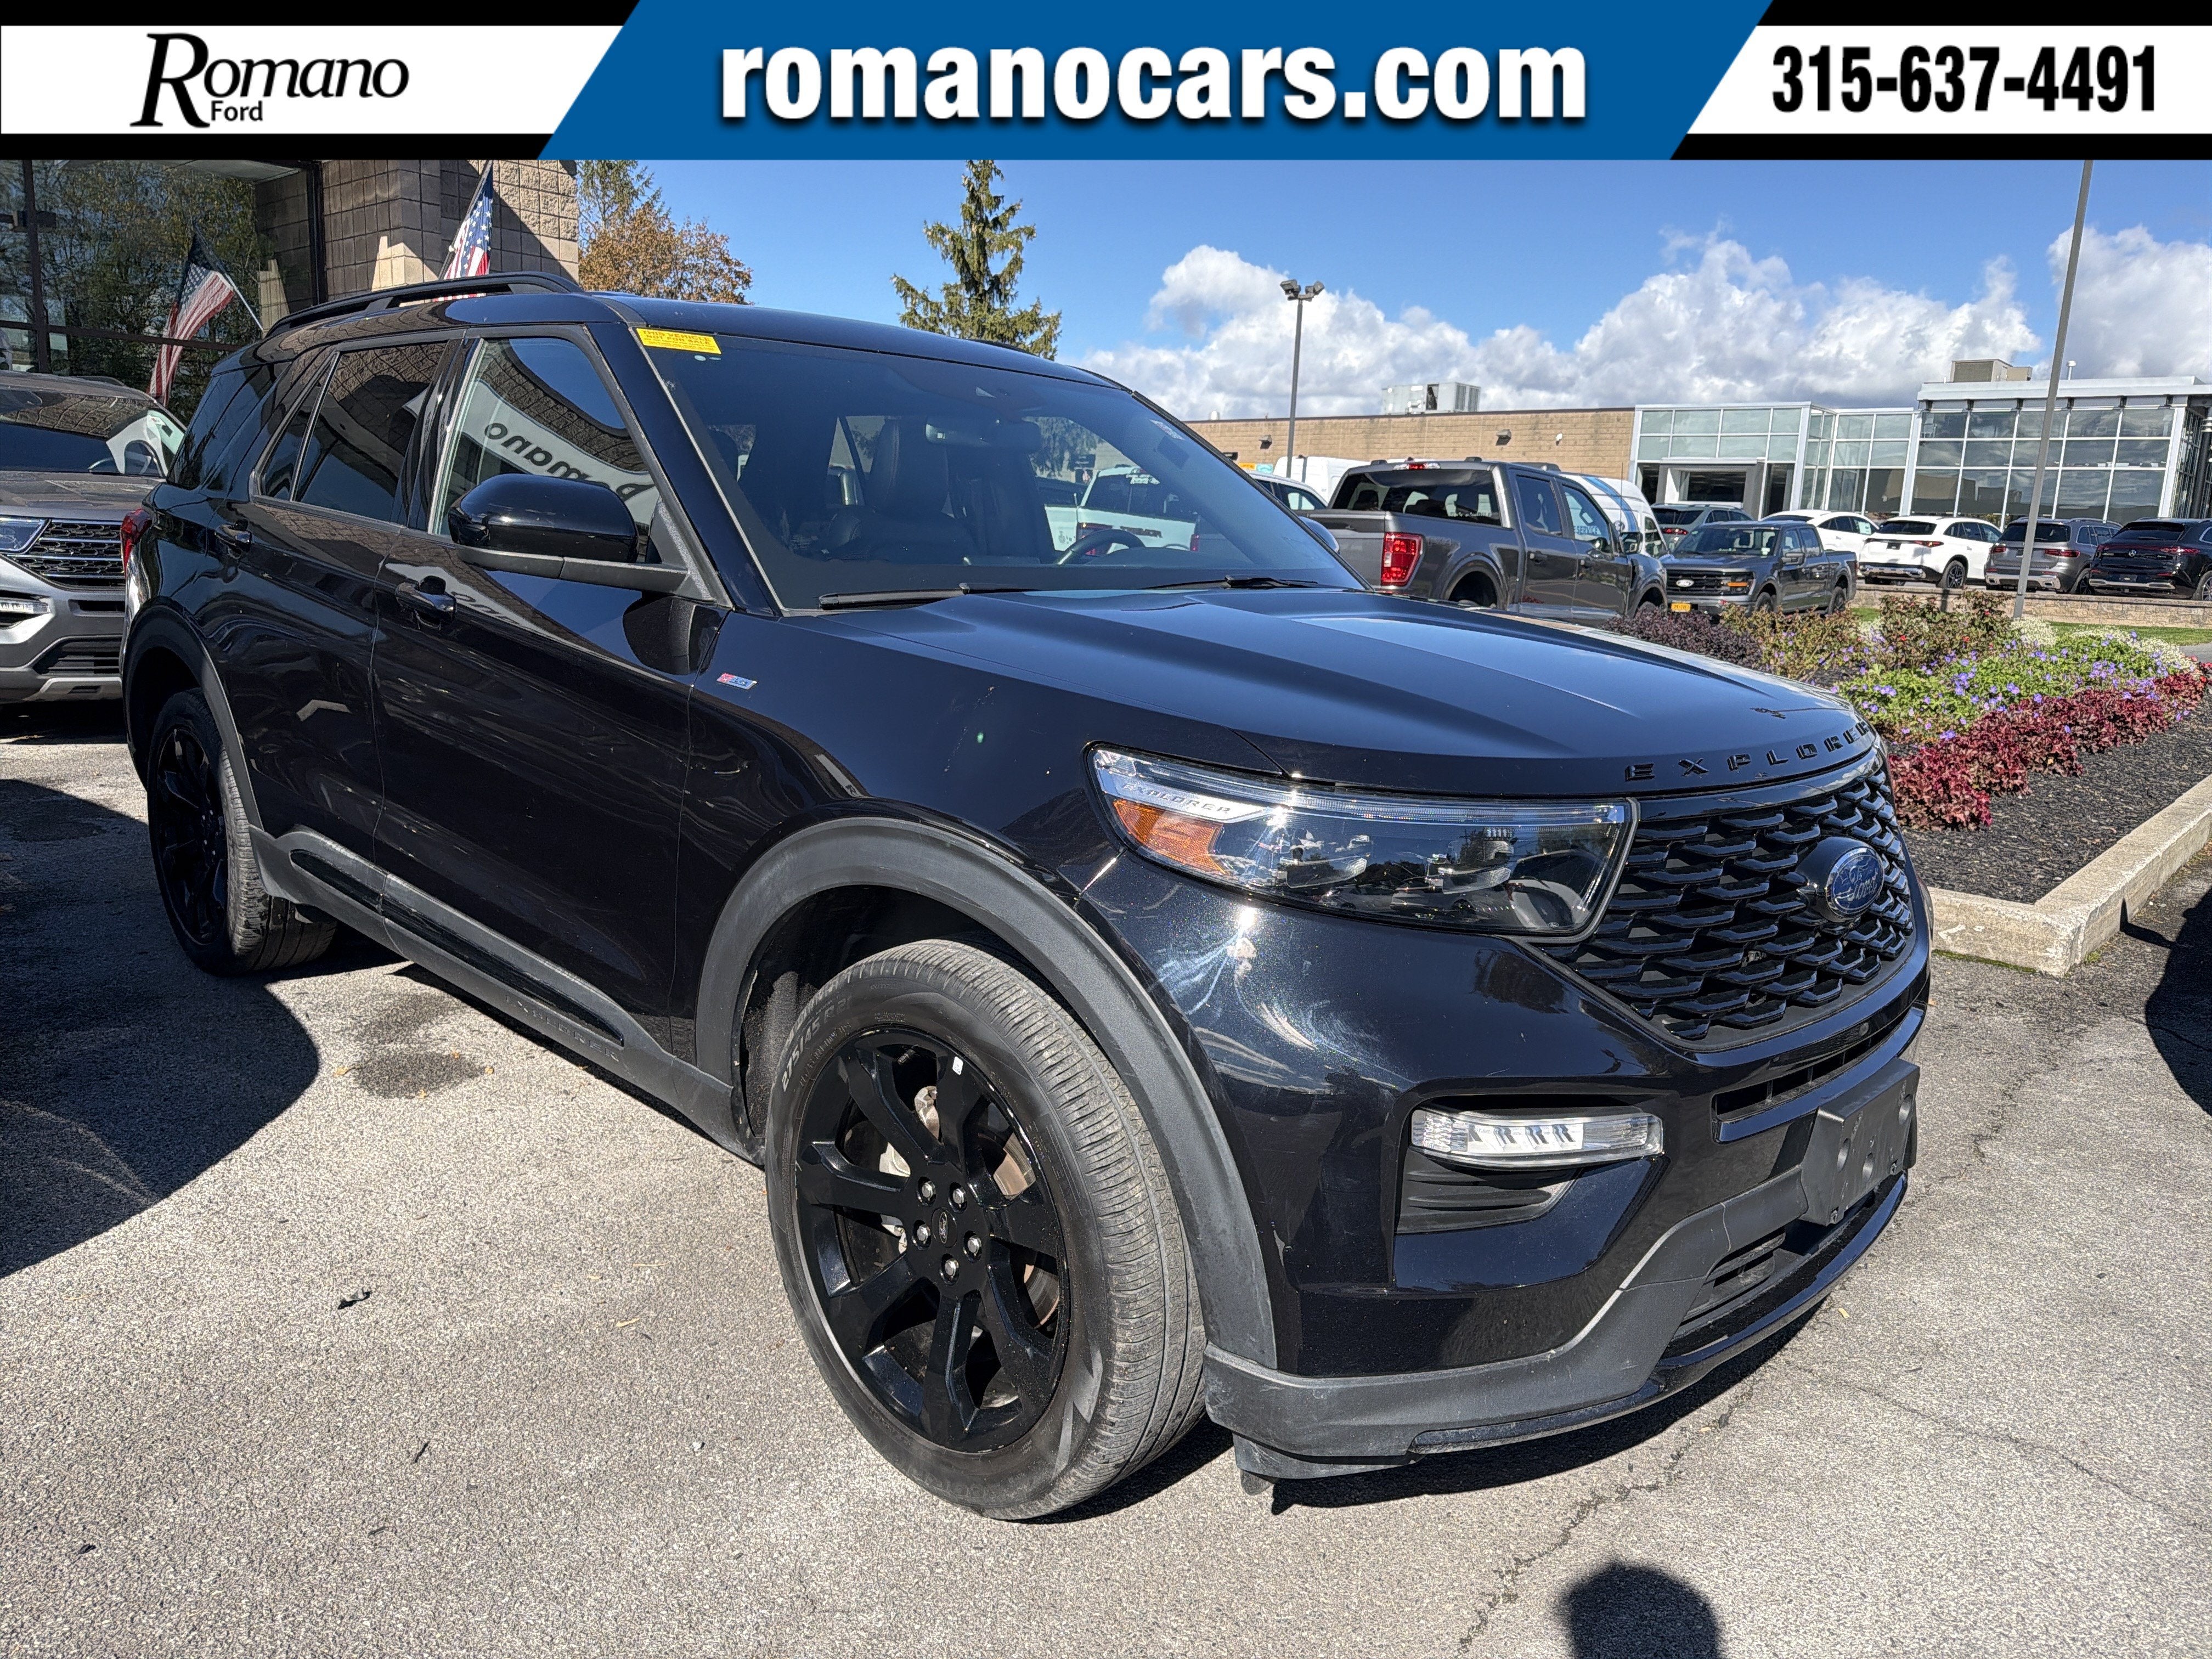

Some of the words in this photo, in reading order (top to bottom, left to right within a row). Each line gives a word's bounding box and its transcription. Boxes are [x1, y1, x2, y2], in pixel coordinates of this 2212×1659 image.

[1624, 720, 1870, 782] EXPLORER
[1123, 782, 1231, 814] EXPLORER
[1835, 856, 1879, 902] Ford
[781, 1016, 820, 1092] 275/45
